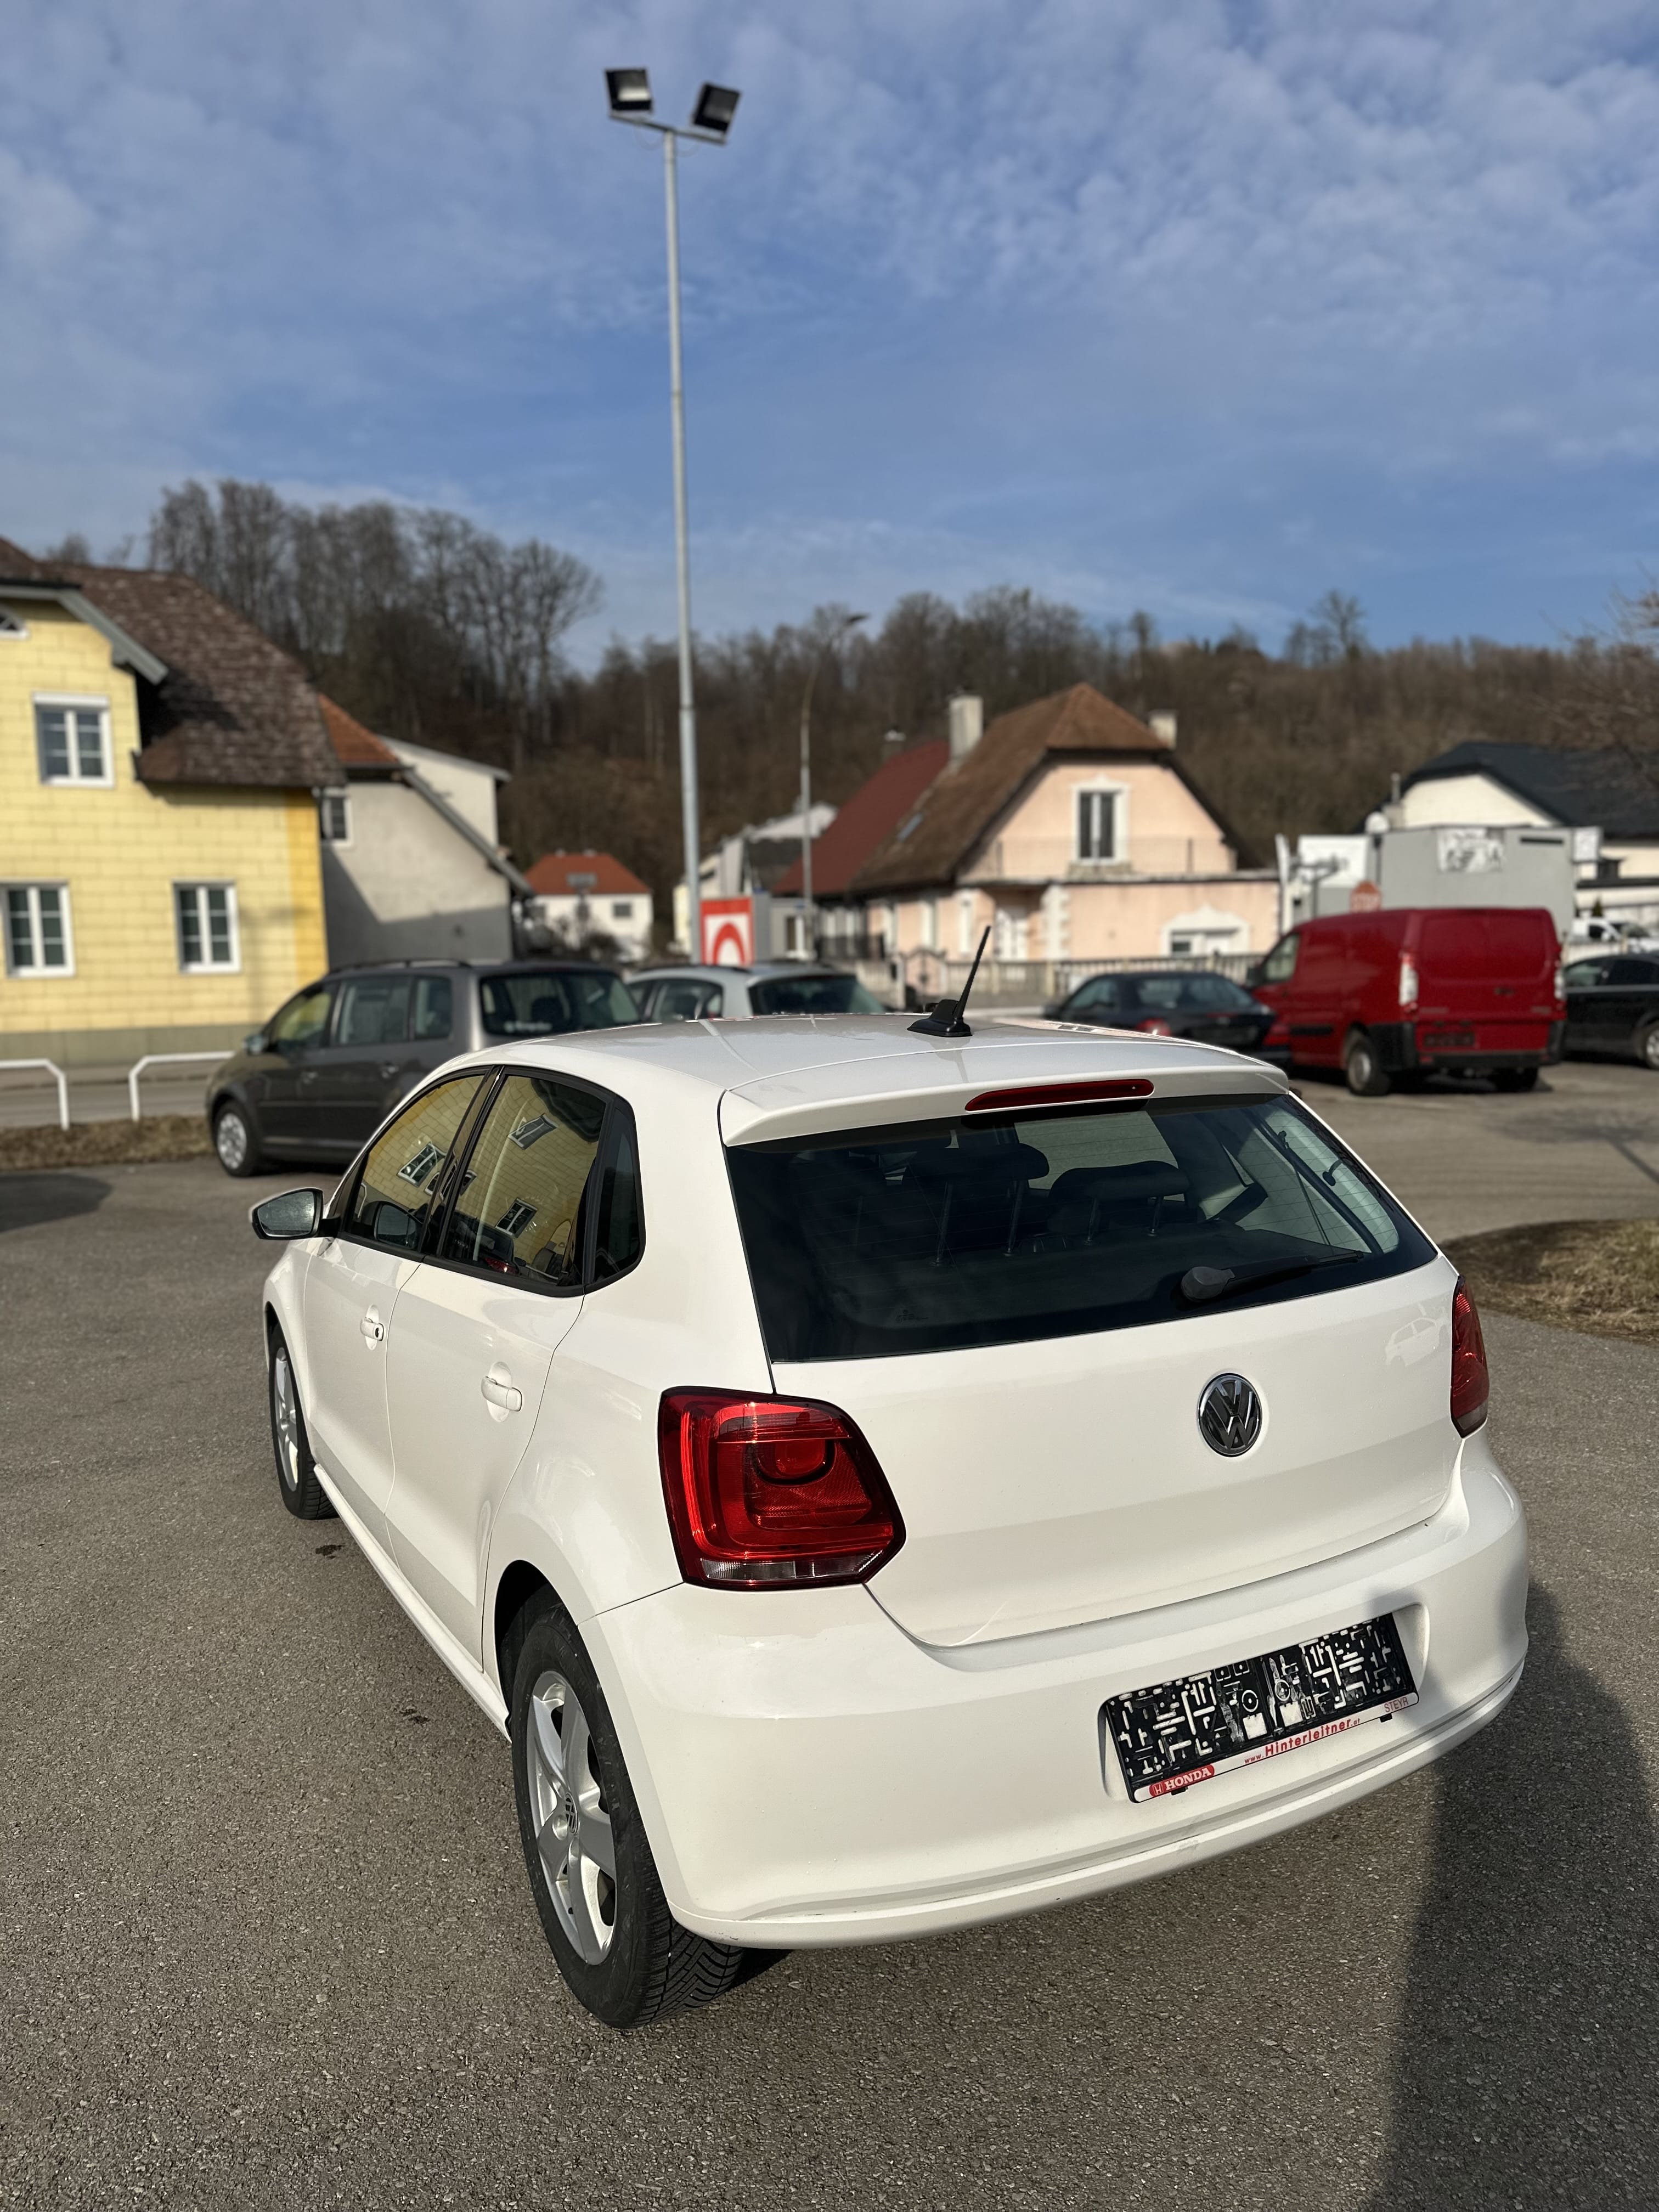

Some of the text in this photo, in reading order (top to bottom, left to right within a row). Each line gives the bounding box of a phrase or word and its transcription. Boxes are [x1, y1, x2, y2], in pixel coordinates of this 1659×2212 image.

[1199, 1374, 1262, 1457] VW
[1165, 1767, 1212, 1791] HONDA
[1383, 1696, 1409, 1713] STEYR
